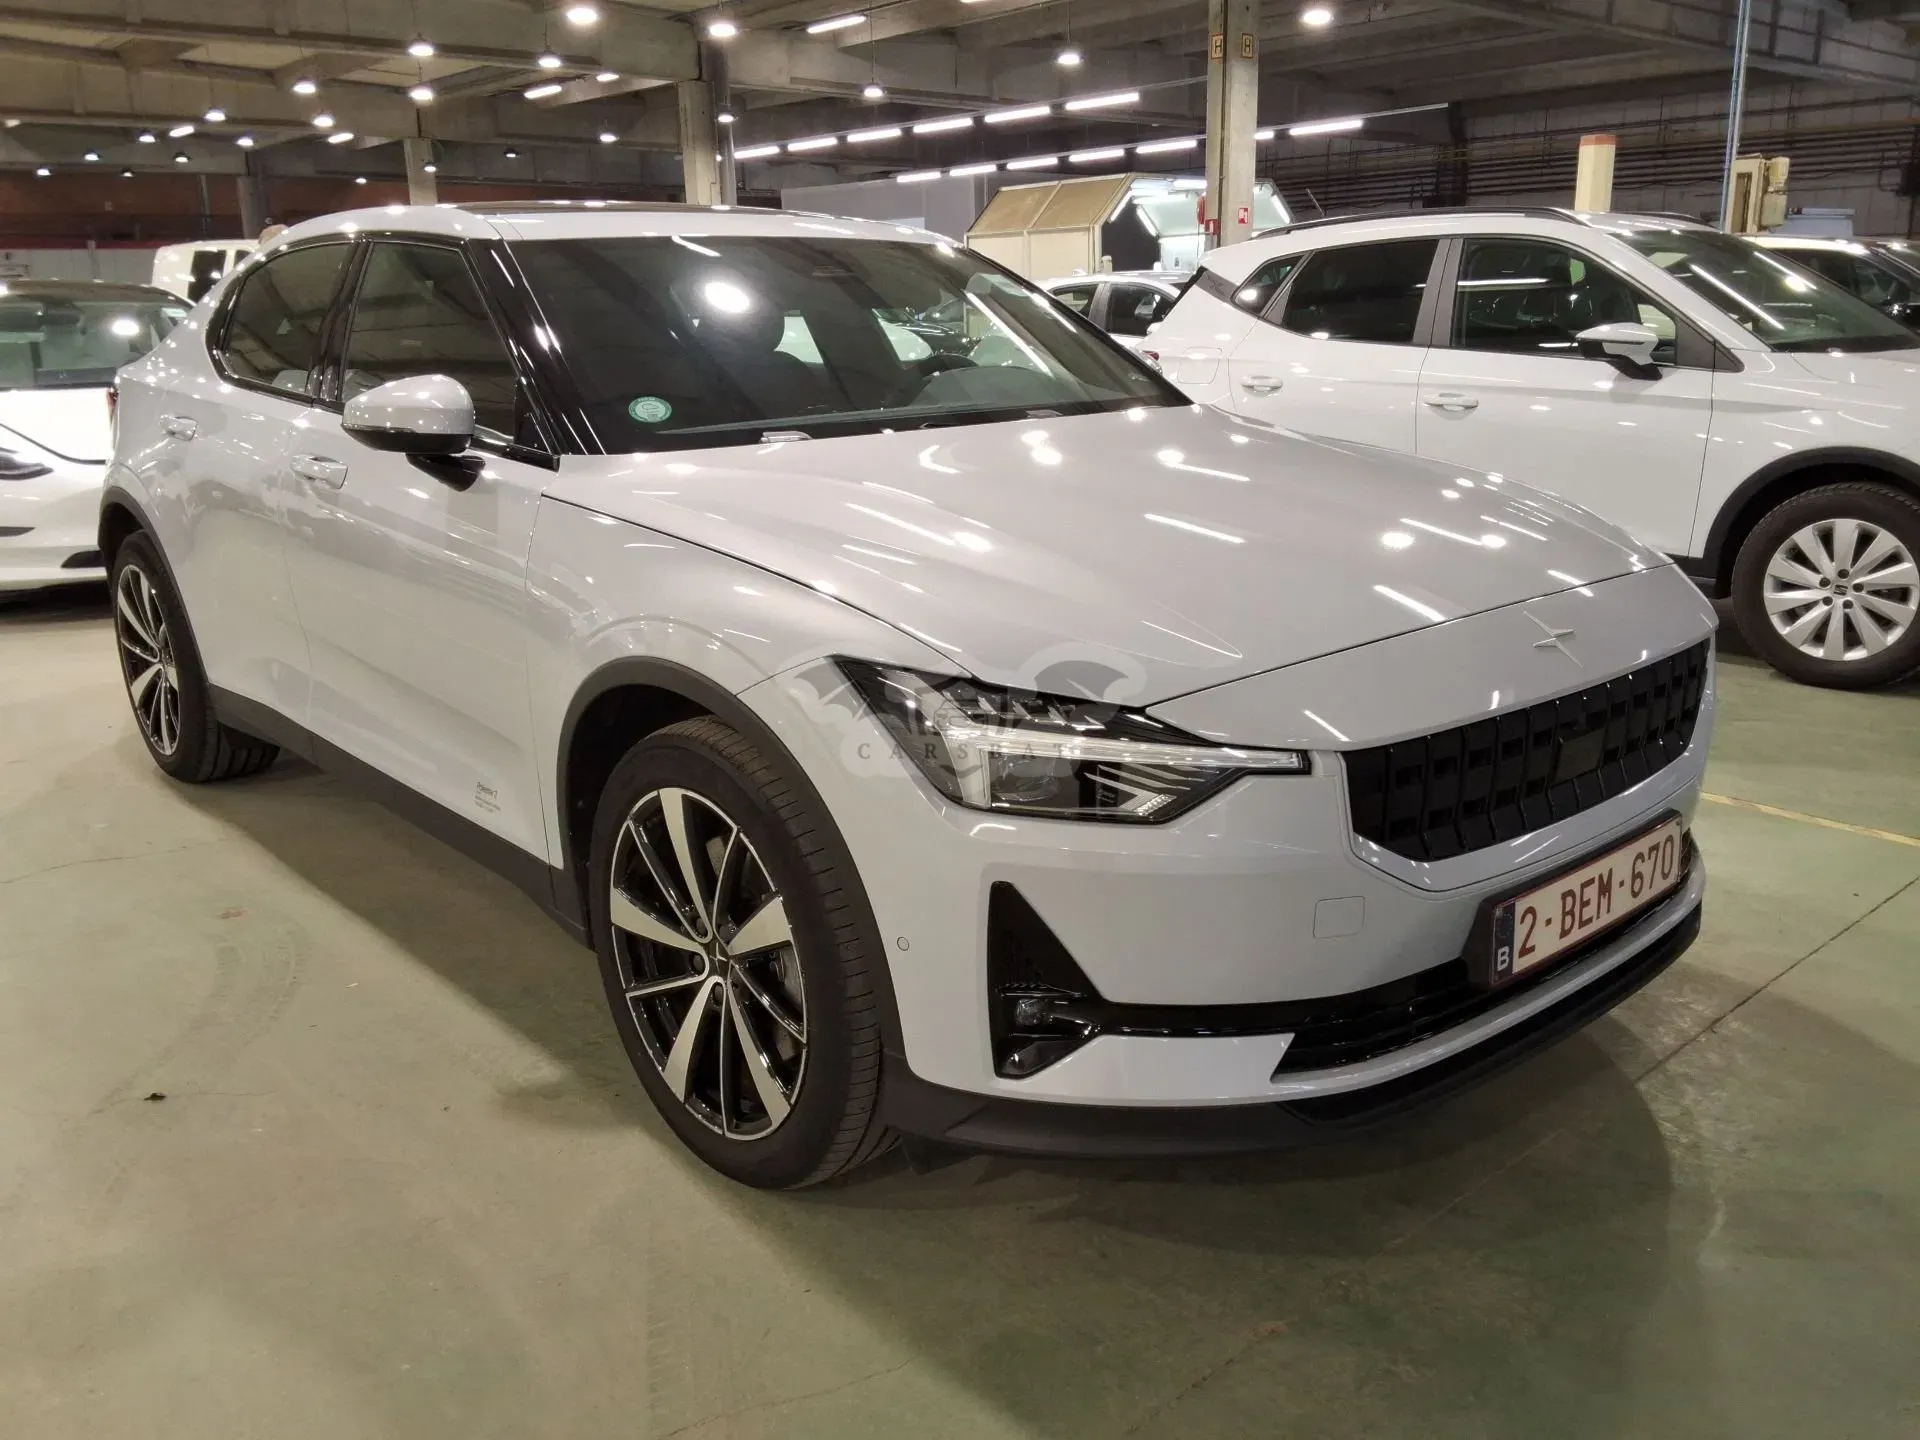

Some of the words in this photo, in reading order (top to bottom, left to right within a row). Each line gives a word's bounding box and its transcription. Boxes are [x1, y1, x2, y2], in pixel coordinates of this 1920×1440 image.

[1214, 38, 1223, 55] H
[1517, 834, 1675, 960] 2-BEM-670
[1496, 945, 1510, 972] B
